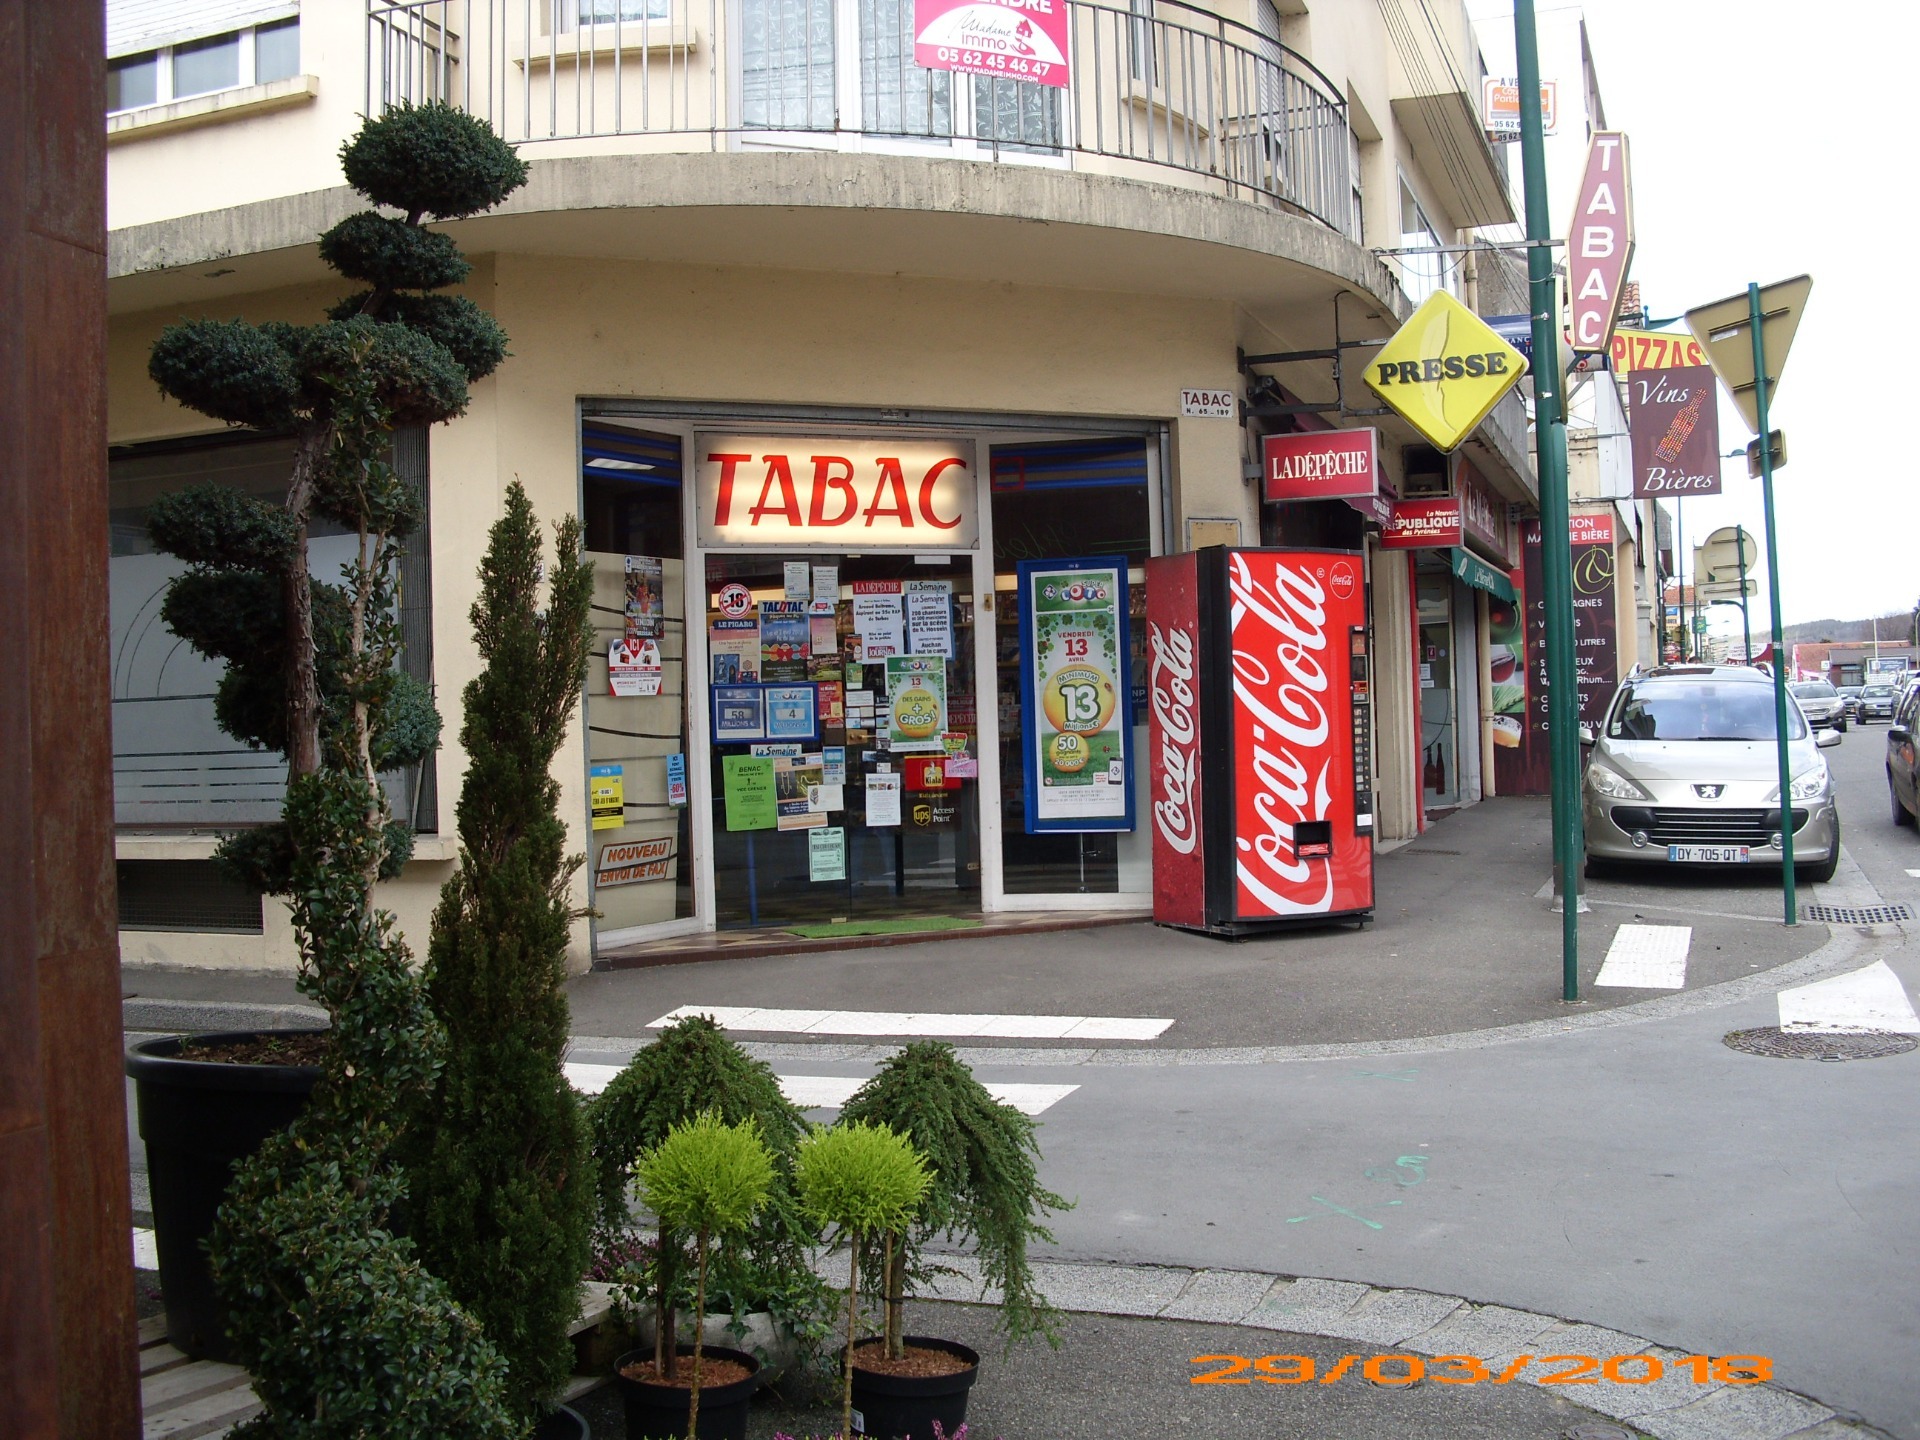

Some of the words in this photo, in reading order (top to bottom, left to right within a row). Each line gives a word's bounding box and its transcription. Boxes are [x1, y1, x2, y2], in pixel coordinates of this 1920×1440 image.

[953, 10, 1012, 36] Madame
[961, 32, 1007, 50] immo
[937, 47, 959, 62] 05
[963, 52, 982, 66] 62
[986, 56, 1005, 69] 45
[1009, 60, 1028, 73] 46
[1032, 63, 1050, 76] 47
[951, 64, 1039, 83] WWW.MADAMEIMMO.COM
[1500, 77, 1506, 86] A
[1494, 120, 1504, 128] 05
[1577, 140, 1619, 344] TABAC
[1611, 335, 1702, 373] PIZZAS
[1377, 351, 1508, 386] PRESSE
[1635, 375, 1690, 406] Vins
[1183, 391, 1231, 406] TABAC
[1272, 456, 1293, 480] LA
[1293, 449, 1368, 478] DÉPÊCHE
[1643, 467, 1714, 491] Bières
[707, 453, 967, 530] TABAC
[1581, 527, 1610, 540] BIÈRE
[909, 582, 917, 591] La
[918, 581, 947, 592] Semaine
[1081, 579, 1104, 588] SUPER
[1061, 584, 1106, 601] LOTO
[629, 639, 639, 651] ICI
[1065, 639, 1088, 656] 13
[1580, 638, 1606, 646] LITRES
[911, 678, 921, 686] 13
[1058, 671, 1098, 682] MINIMUM
[1061, 684, 1099, 720] 13
[788, 709, 796, 718] 4
[1058, 736, 1077, 750] 50
[1150, 620, 1197, 855] Coca-Cola
[755, 748, 764, 757] La
[765, 746, 798, 757] Semaine
[738, 765, 761, 773] BENAC
[925, 775, 942, 785] Kiala
[915, 811, 930, 822] ups
[933, 806, 955, 814] Access
[932, 814, 950, 822] Point
[607, 842, 667, 863] NOUVEAU
[600, 867, 631, 883] ENVOI
[632, 863, 645, 879] DE
[647, 860, 666, 877] FAX
